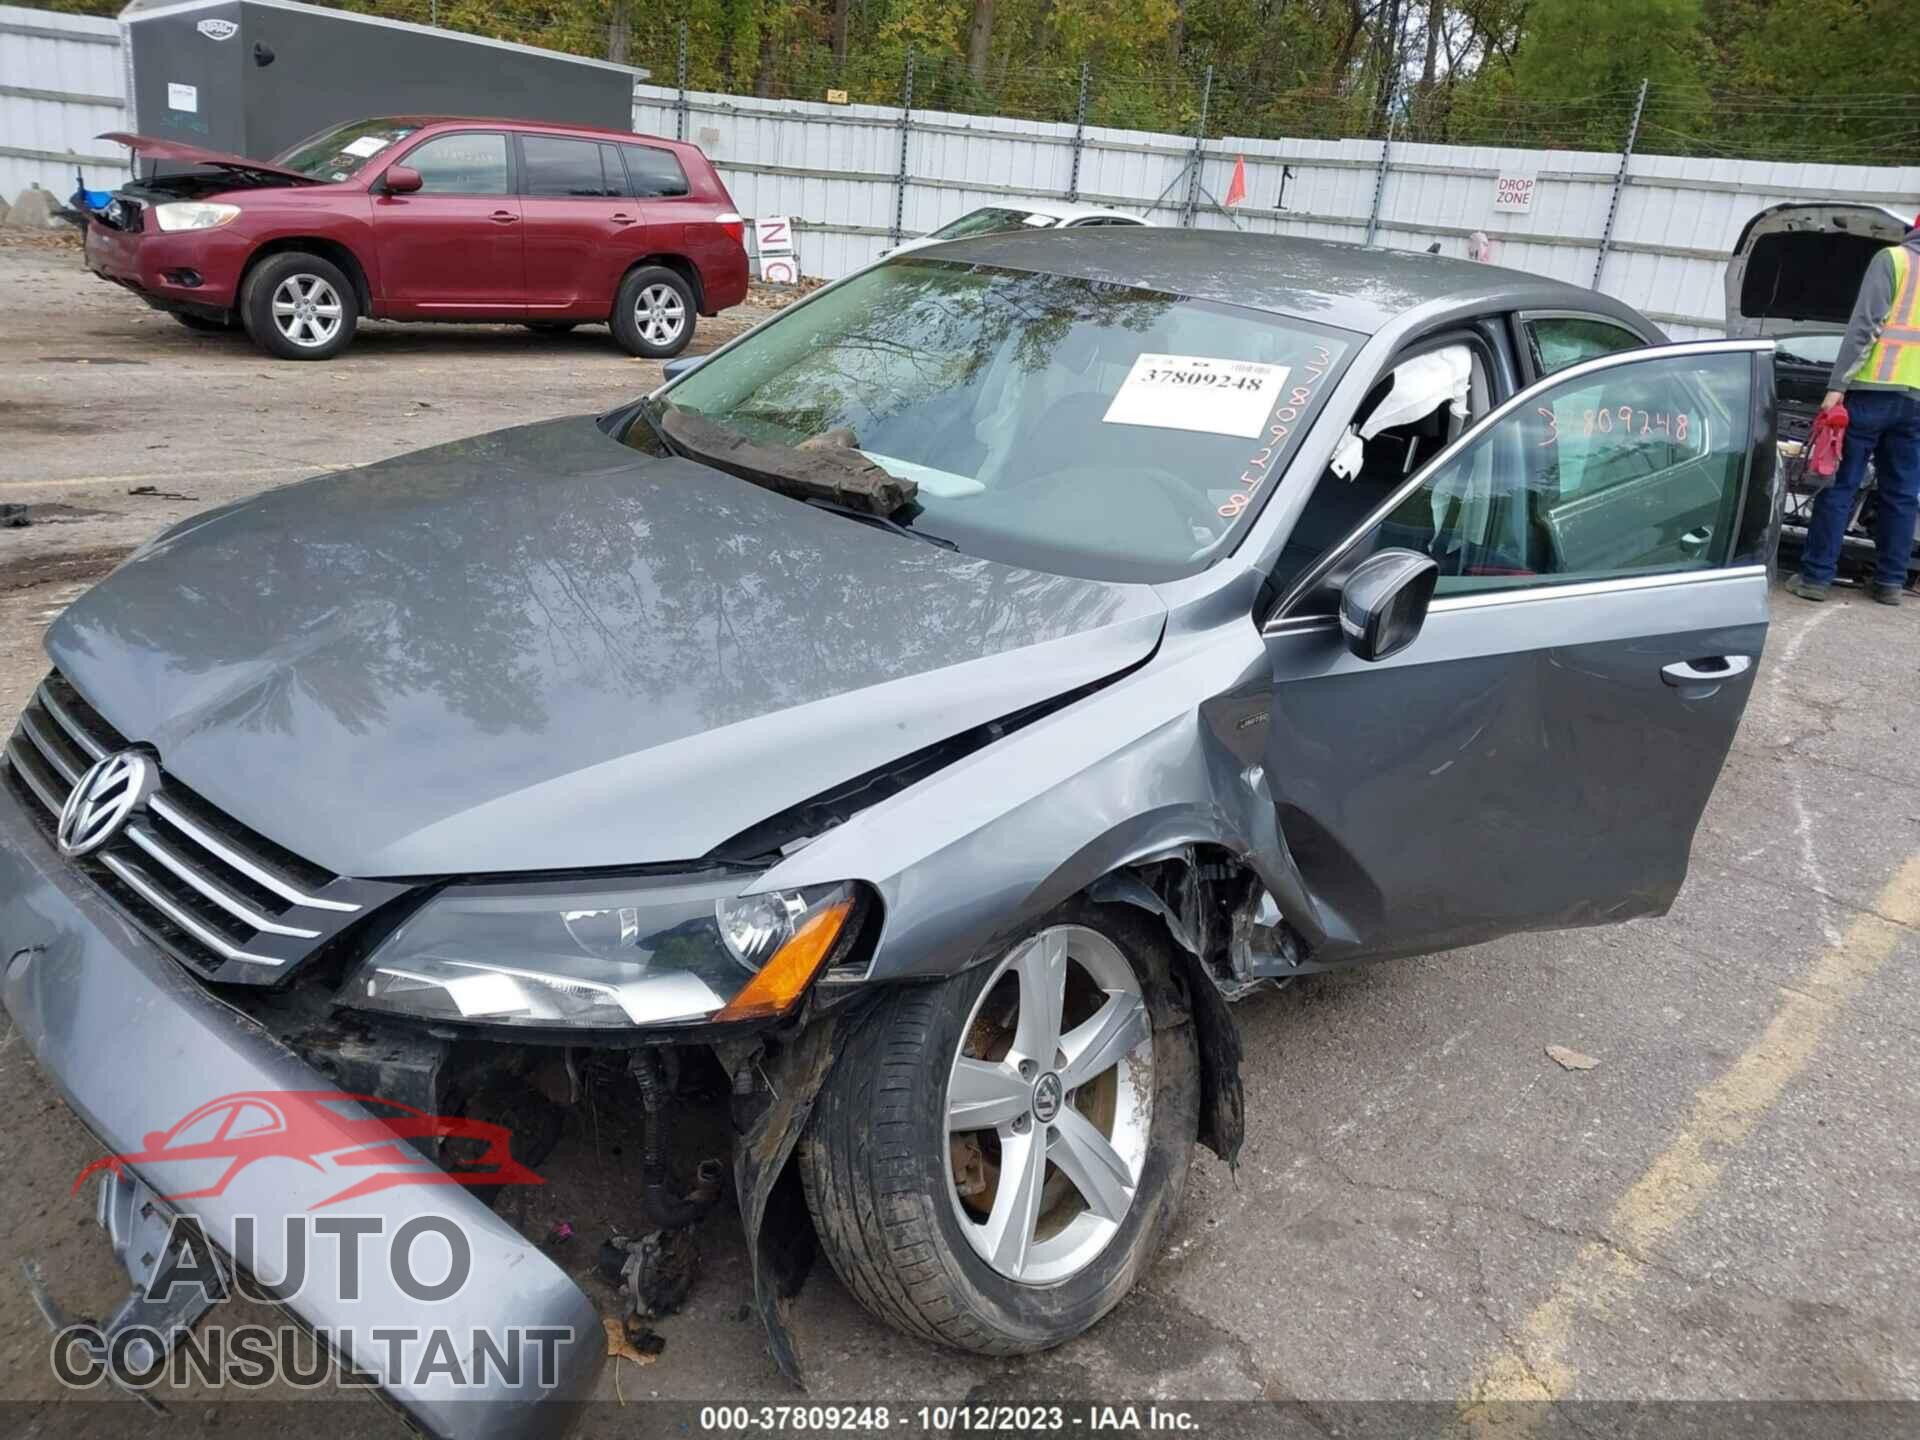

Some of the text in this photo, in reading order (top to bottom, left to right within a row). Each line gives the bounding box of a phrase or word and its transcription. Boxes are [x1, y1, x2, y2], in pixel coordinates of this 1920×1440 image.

[1499, 179, 1533, 191] DROP
[1496, 191, 1530, 204] ZONE
[1141, 369, 1263, 391] 37809248
[1536, 405, 1689, 446] 3809248
